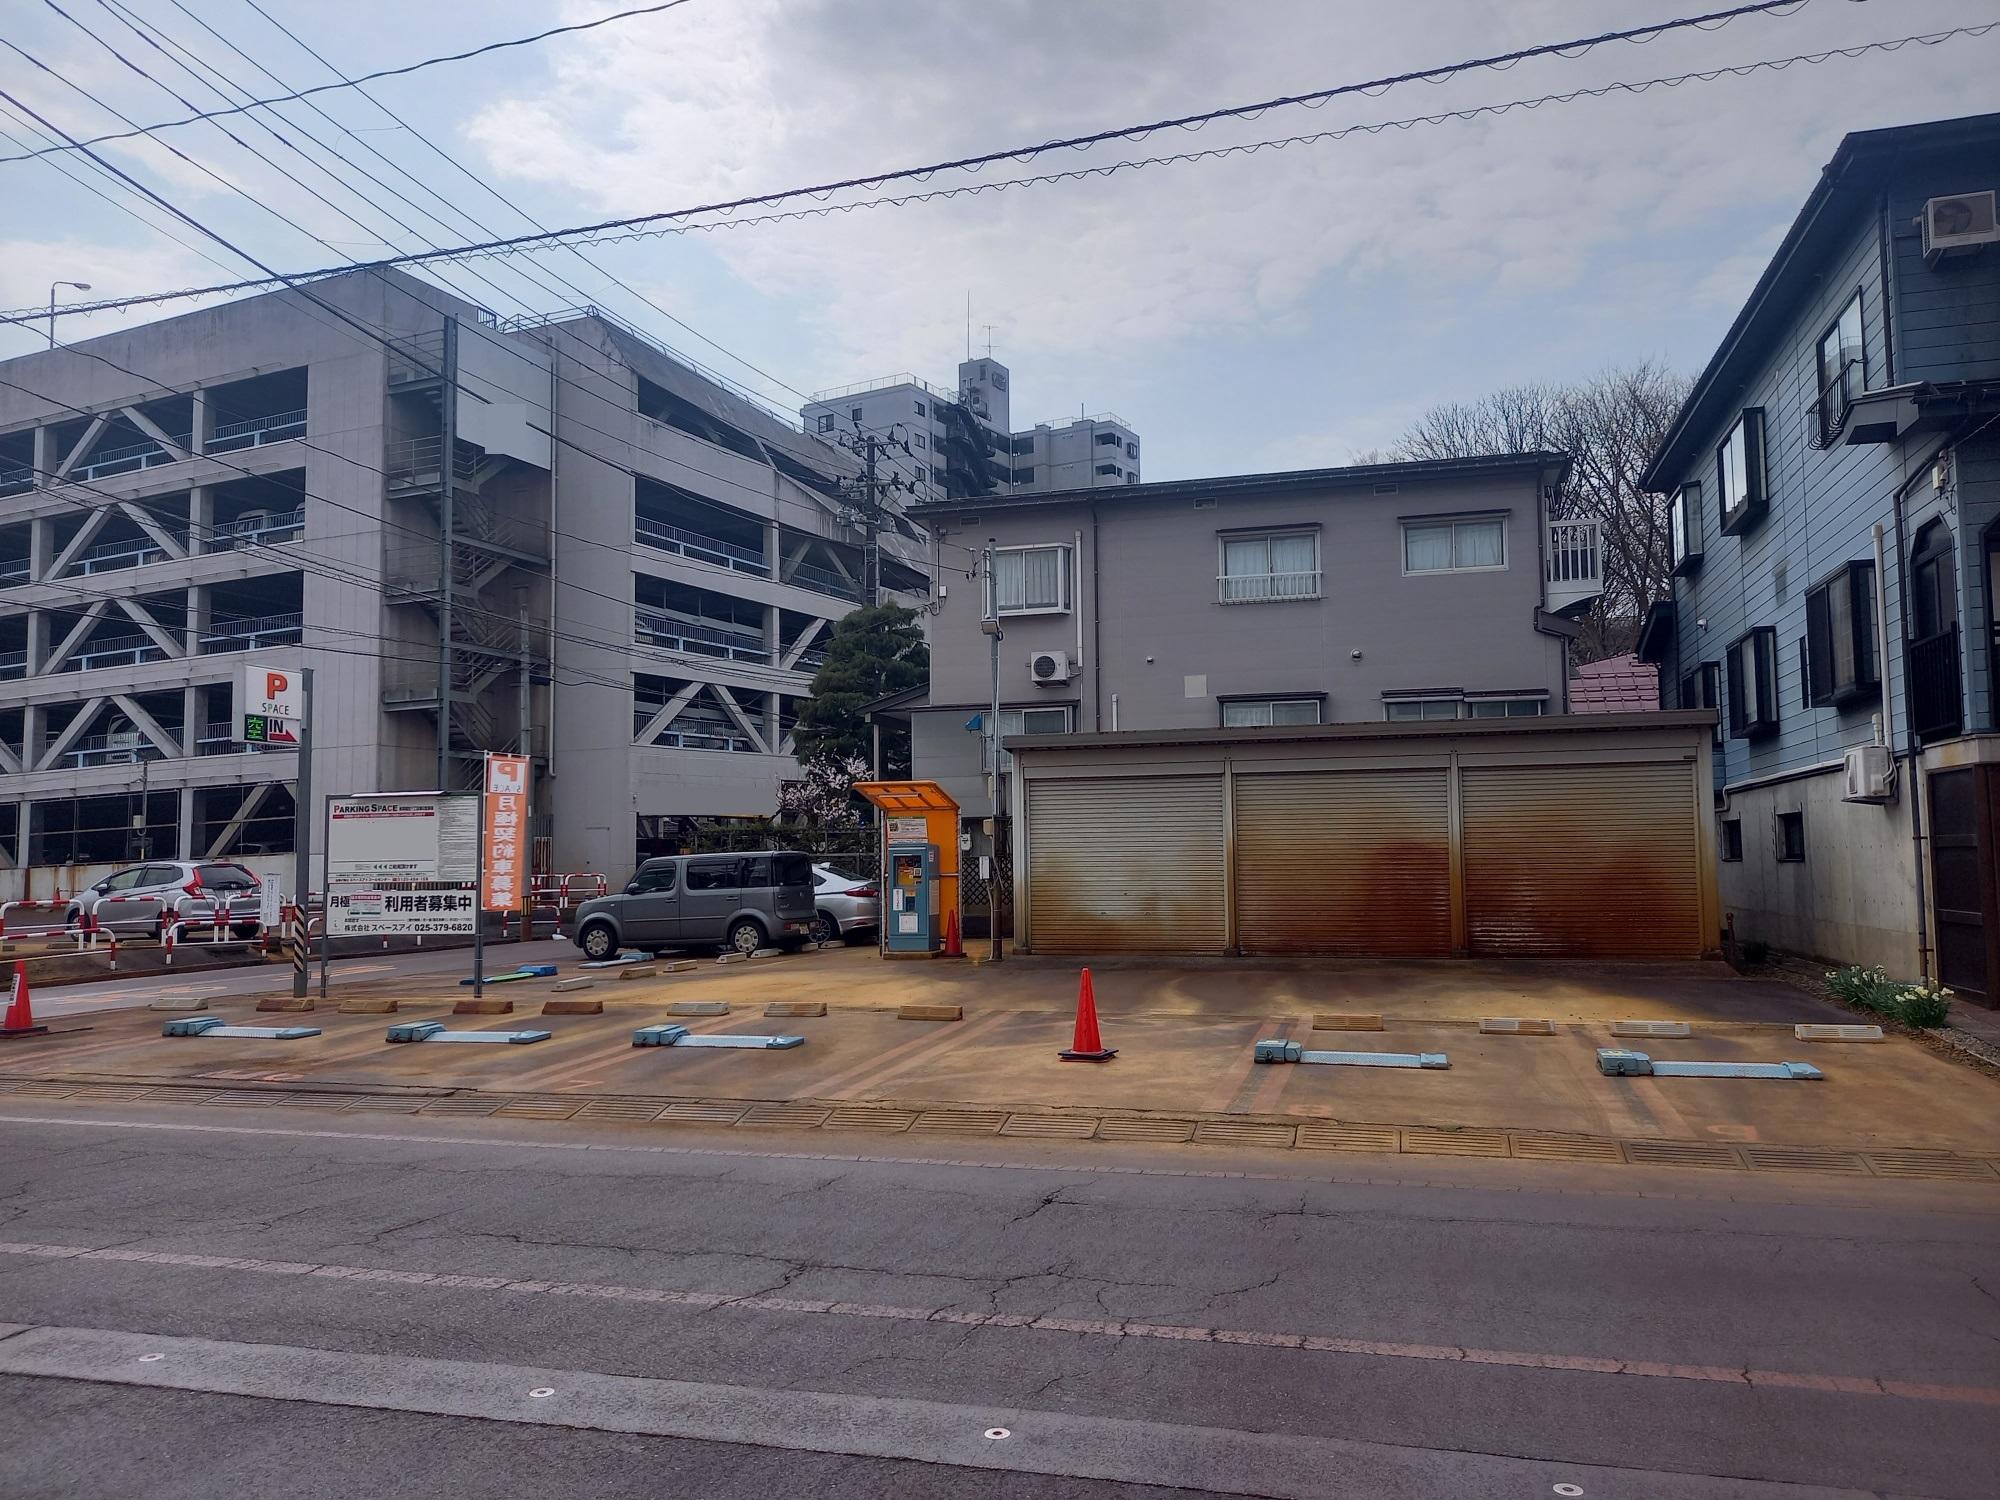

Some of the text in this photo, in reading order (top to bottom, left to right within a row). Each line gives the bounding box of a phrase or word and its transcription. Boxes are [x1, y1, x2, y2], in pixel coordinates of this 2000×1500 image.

[267, 672, 288, 700] P
[262, 702, 289, 715] SPACE
[247, 717, 264, 739] 空
[269, 718, 284, 733] IN
[333, 804, 370, 814] PARKING
[371, 803, 398, 812] SPACE
[330, 895, 350, 908] 月極
[385, 894, 472, 913] 利用者募集中
[345, 924, 370, 932] 株式会社
[414, 923, 473, 931] 025-379-6820
